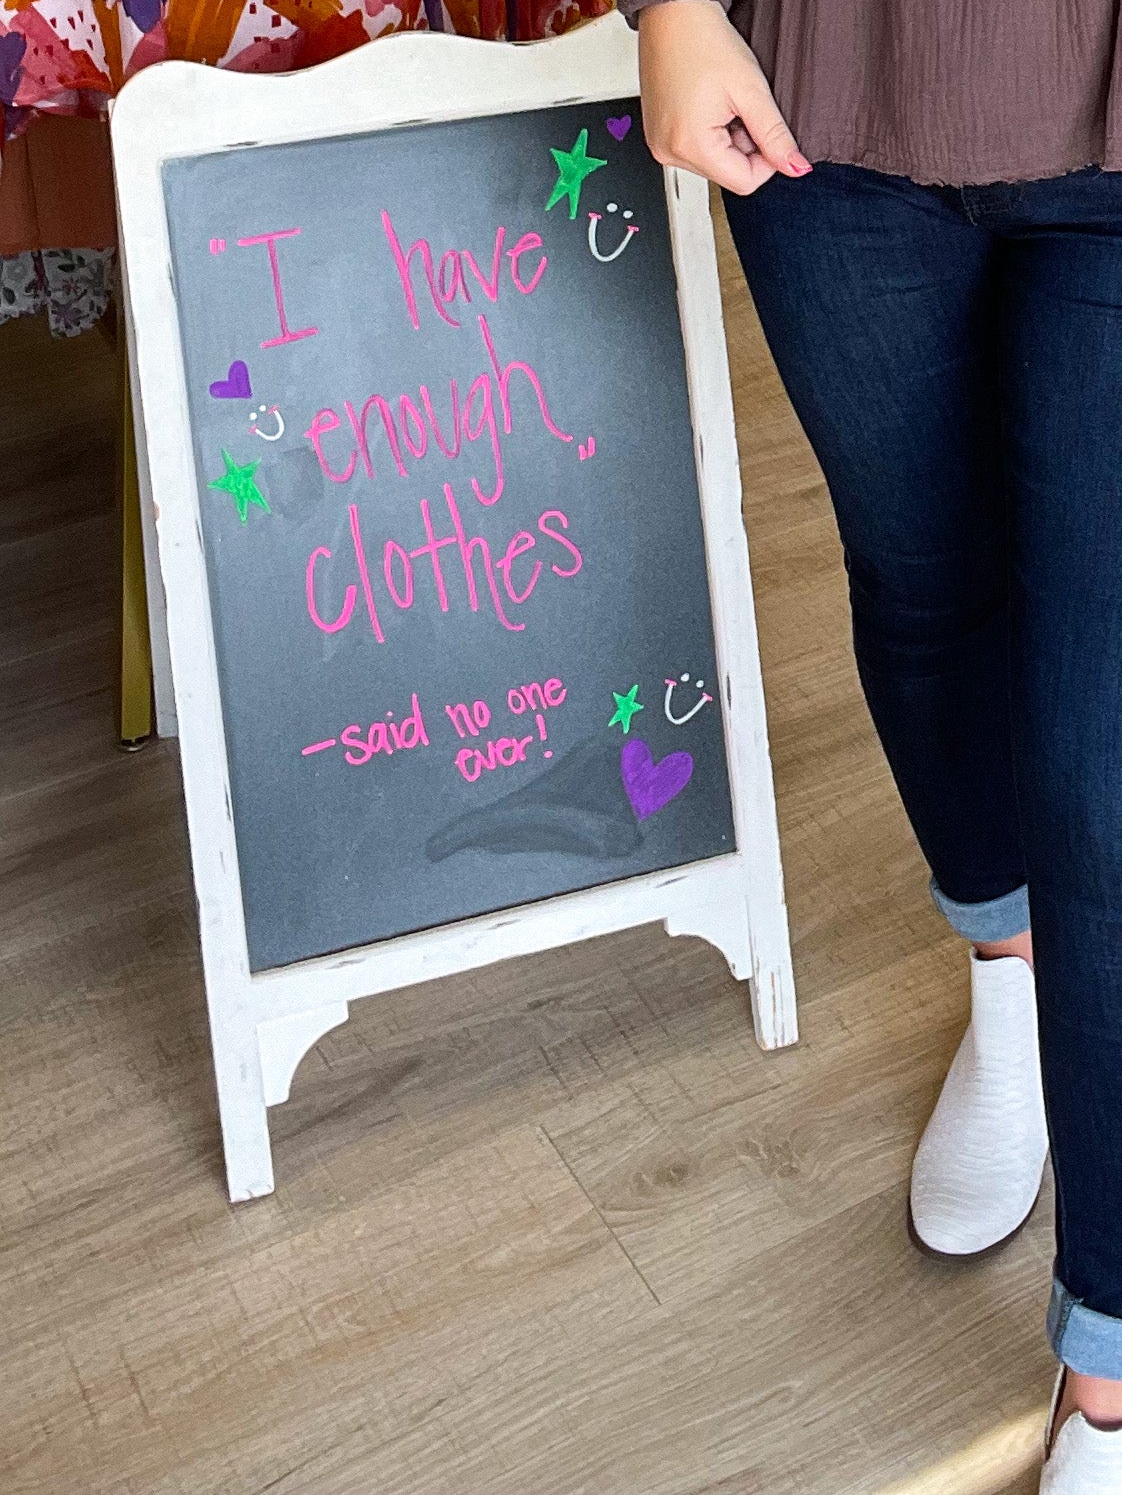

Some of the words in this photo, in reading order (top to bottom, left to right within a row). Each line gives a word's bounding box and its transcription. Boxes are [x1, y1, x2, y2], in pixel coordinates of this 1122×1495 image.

[381, 209, 549, 330] have
[445, 699, 492, 738] no
[507, 677, 568, 715] one
[455, 713, 554, 783] ever!
